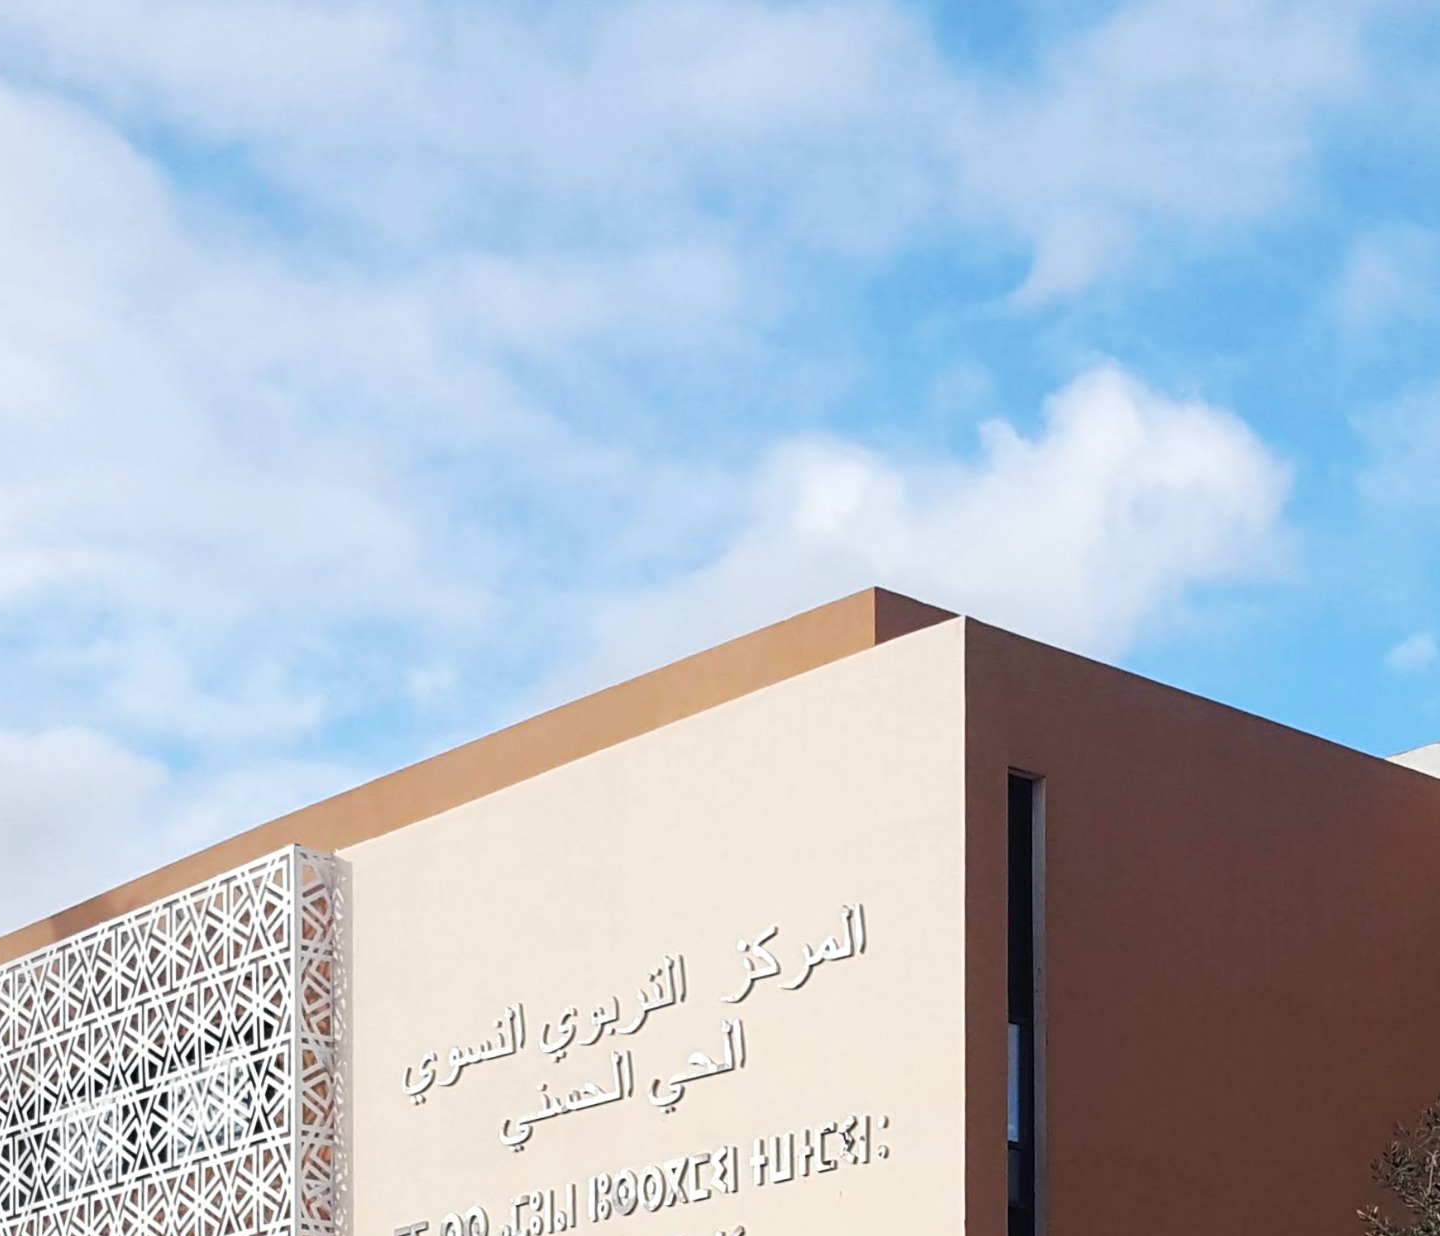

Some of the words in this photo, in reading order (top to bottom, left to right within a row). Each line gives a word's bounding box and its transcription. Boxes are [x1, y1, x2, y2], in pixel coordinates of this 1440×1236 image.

[720, 902, 868, 1003] المركز
[401, 1002, 526, 1104] النسوي
[539, 953, 687, 1061] التربوي
[498, 1049, 634, 1151] الحسني
[647, 1018, 746, 1113] الحي
